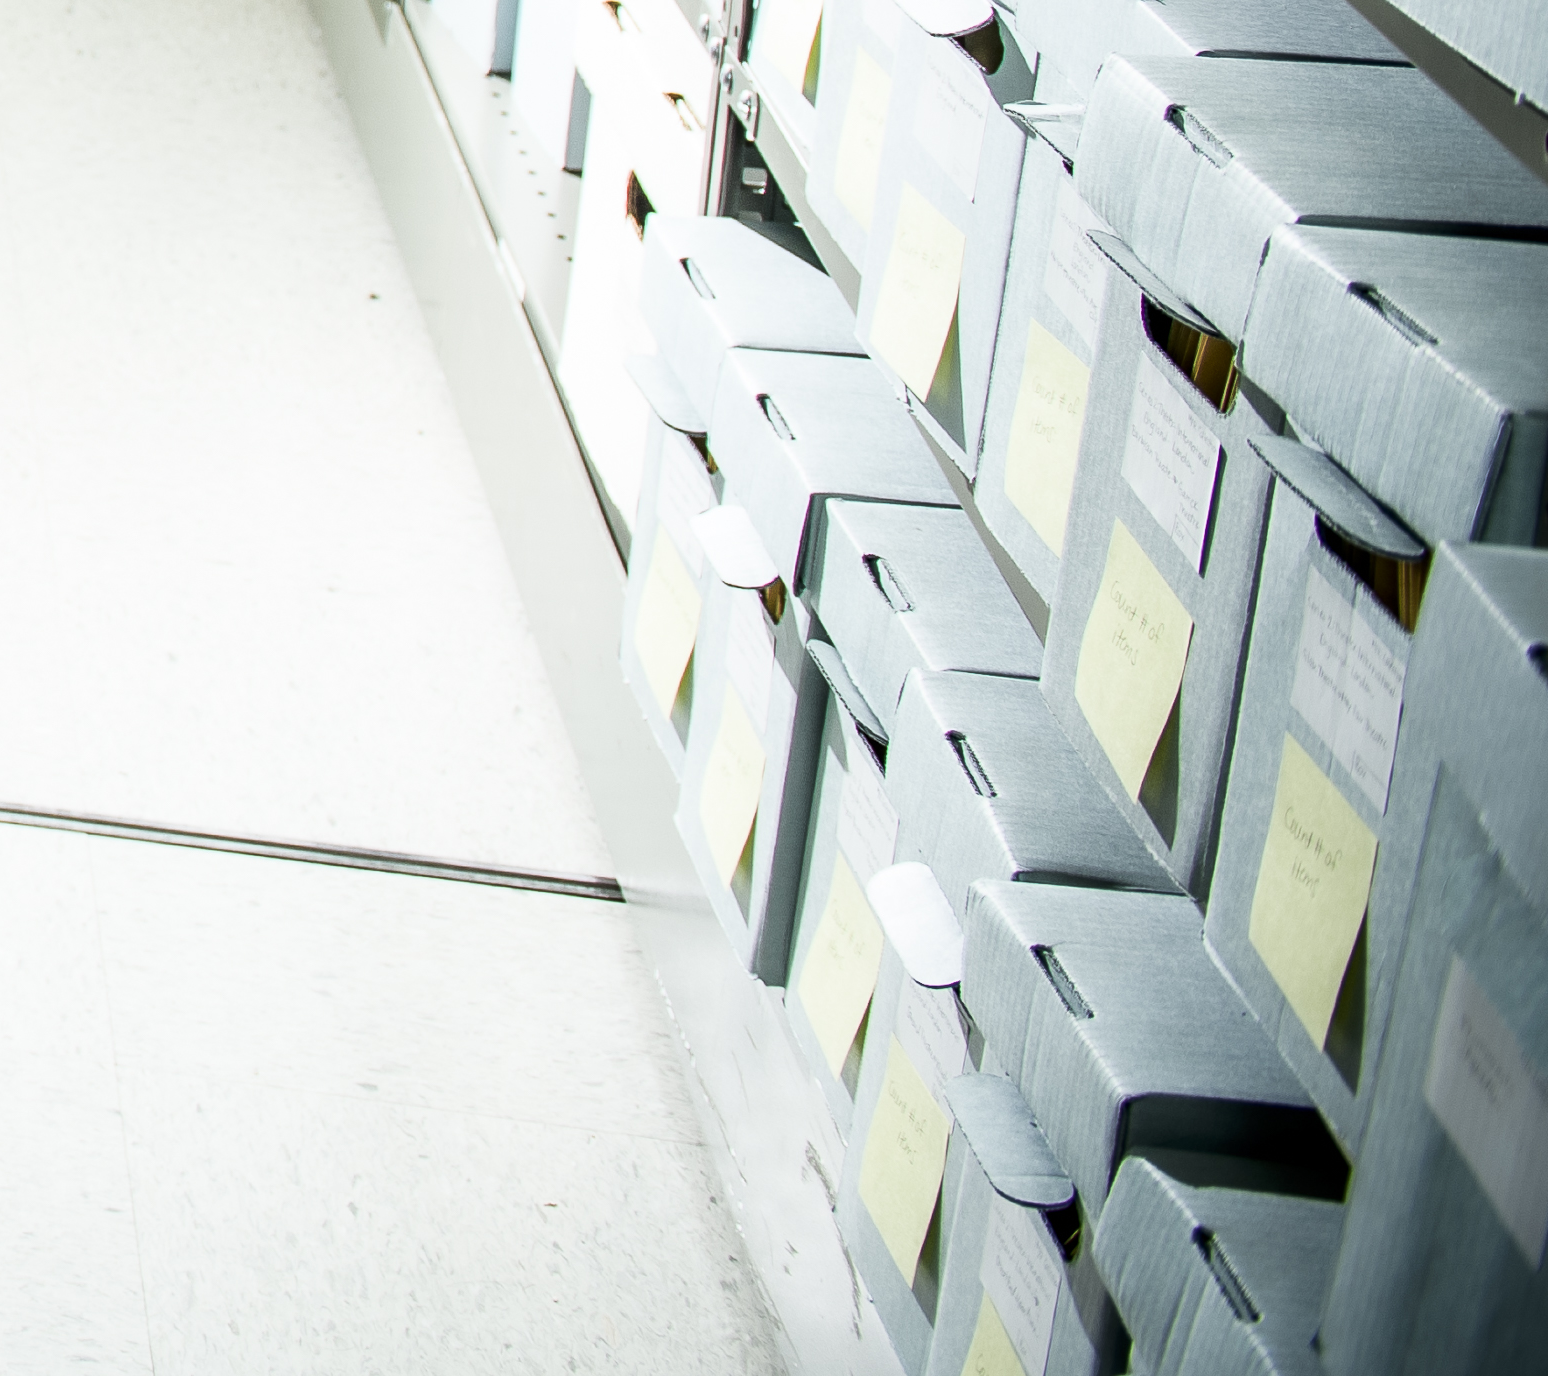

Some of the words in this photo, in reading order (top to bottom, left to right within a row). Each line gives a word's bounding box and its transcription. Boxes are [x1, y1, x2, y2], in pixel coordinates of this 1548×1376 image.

[1110, 580, 1138, 621] Count
[1139, 612, 1148, 634] #
[1148, 622, 1165, 644] of
[1112, 623, 1139, 666] items
[1284, 806, 1314, 850] Count
[1324, 849, 1343, 872] of
